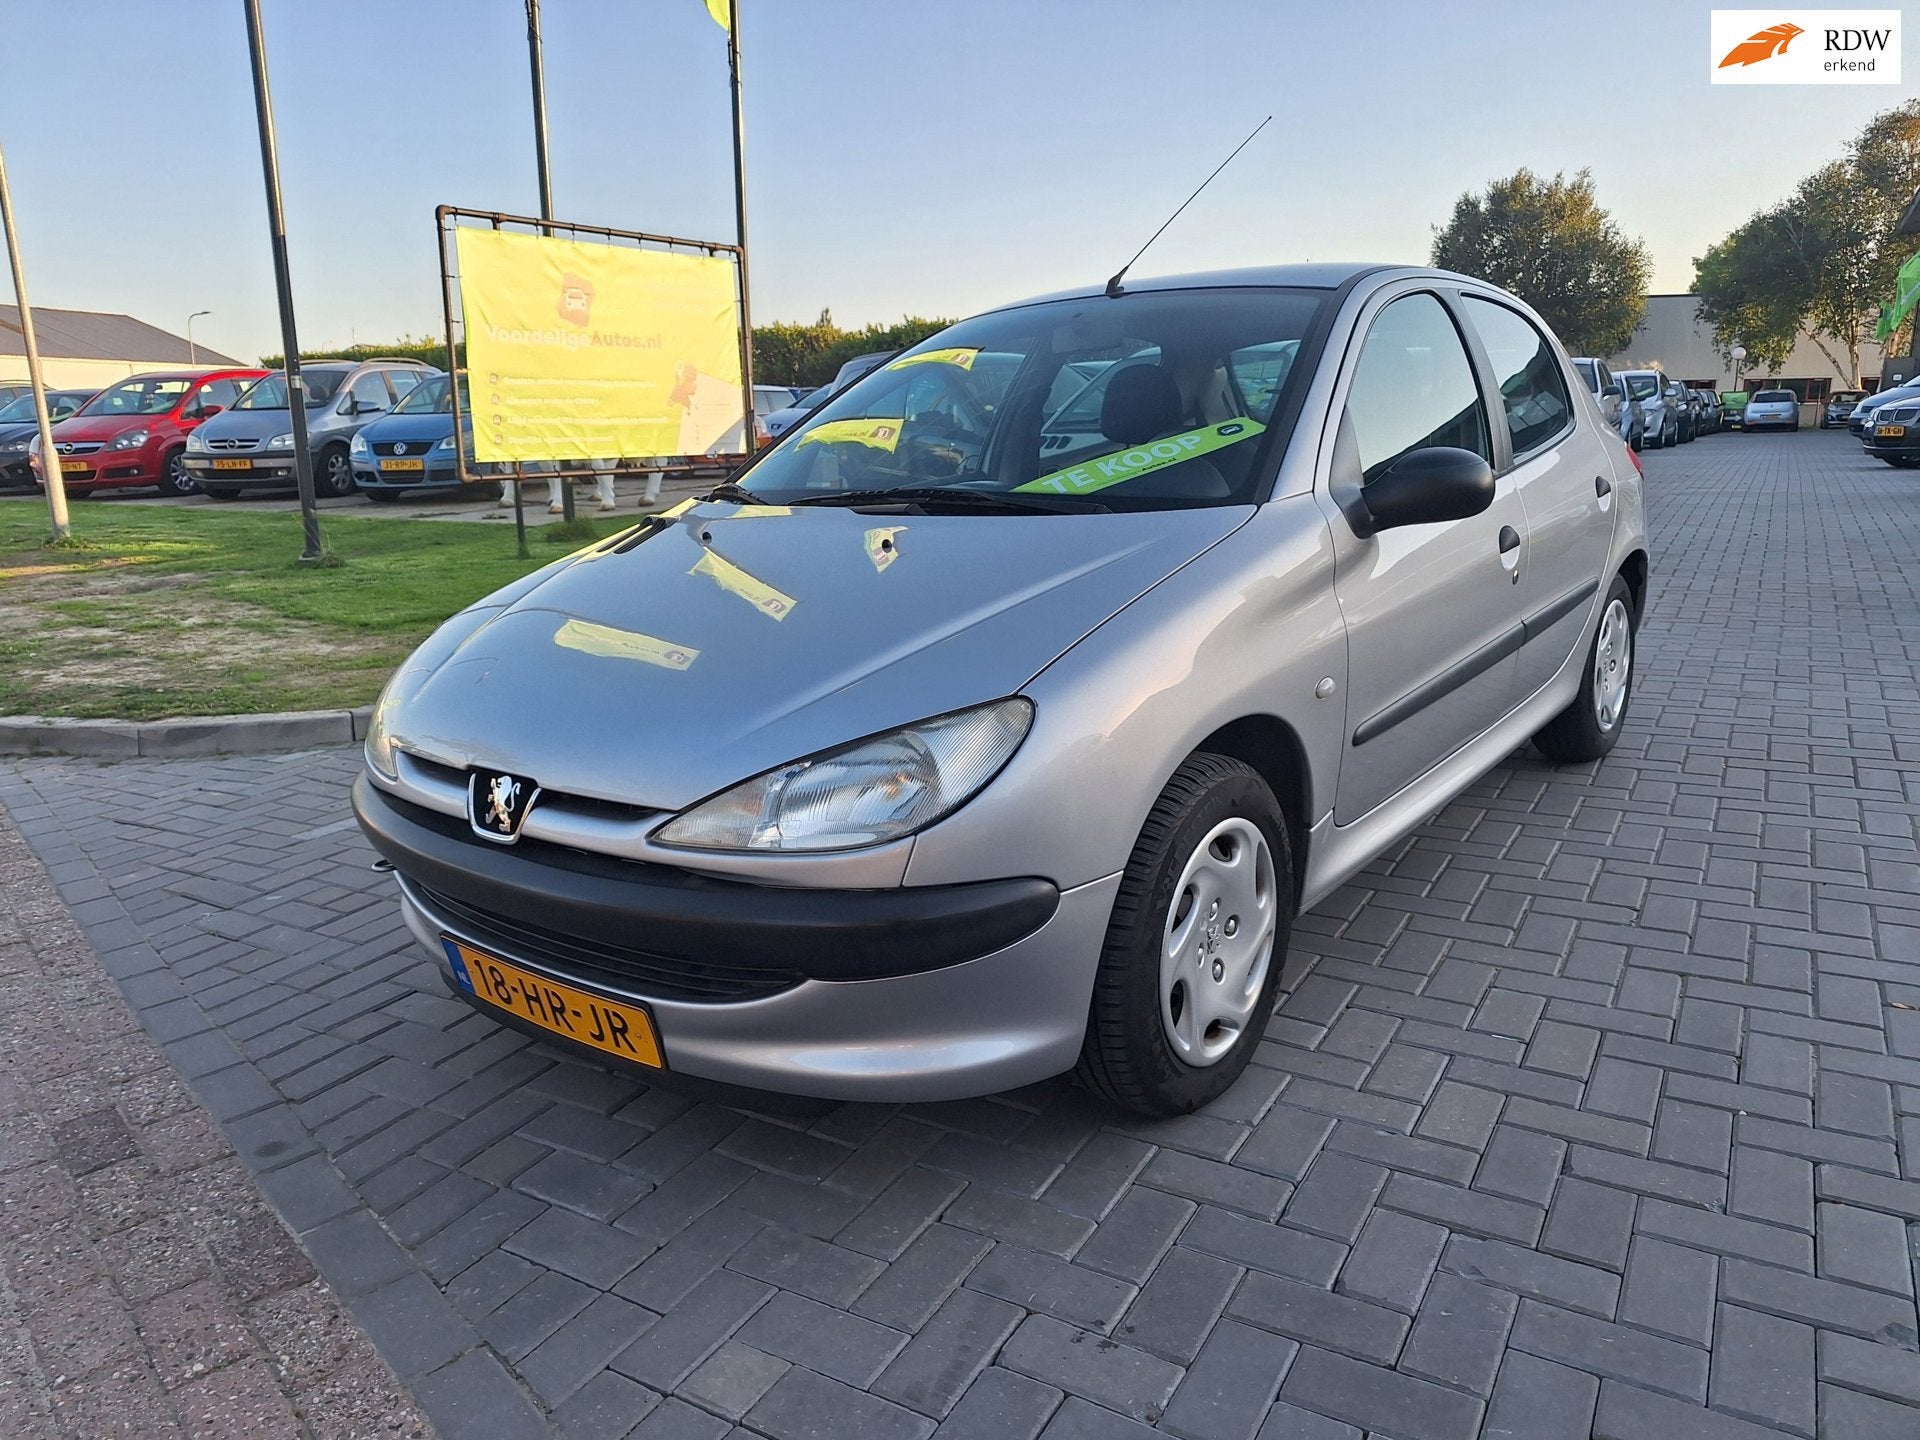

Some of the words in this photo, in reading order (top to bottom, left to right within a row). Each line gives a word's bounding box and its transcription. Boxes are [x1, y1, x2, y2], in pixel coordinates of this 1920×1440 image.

[485, 325, 663, 351] VoordeligeAutos.nl
[1041, 468, 1097, 494] TE
[1095, 434, 1202, 477] KOOP
[473, 959, 638, 1053] 18-HR-JR
